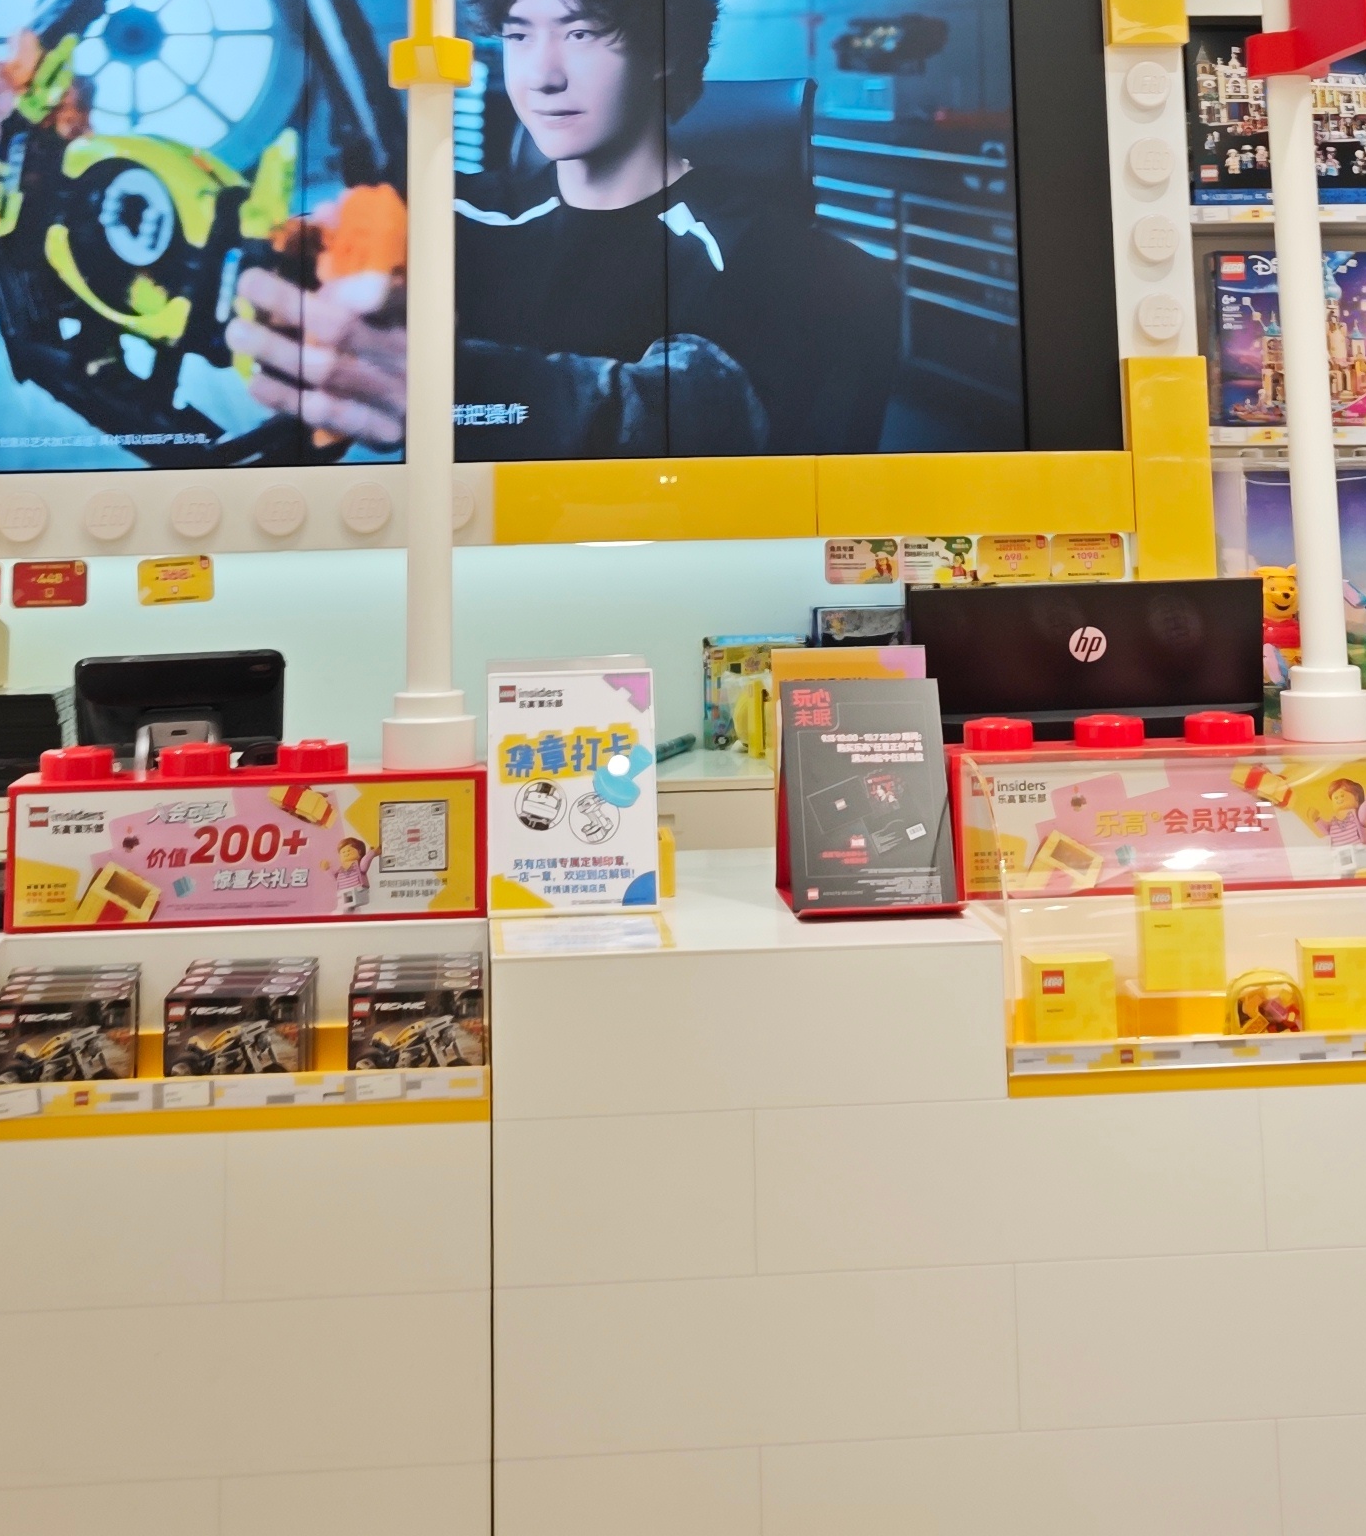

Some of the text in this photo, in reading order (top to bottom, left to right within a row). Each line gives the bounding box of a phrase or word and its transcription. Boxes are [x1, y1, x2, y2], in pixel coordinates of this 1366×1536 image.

[1075, 627, 1103, 662] hp
[518, 688, 564, 698] insiders
[792, 688, 831, 708] 玩心
[794, 708, 833, 727] 未眠
[997, 779, 1047, 792] insiders
[146, 800, 229, 825] 入会可享
[212, 867, 309, 891] 惊喜大礼包
[1151, 893, 1172, 905] LEGO
[1313, 960, 1334, 973] LEGO
[1043, 975, 1065, 989] LEGO
